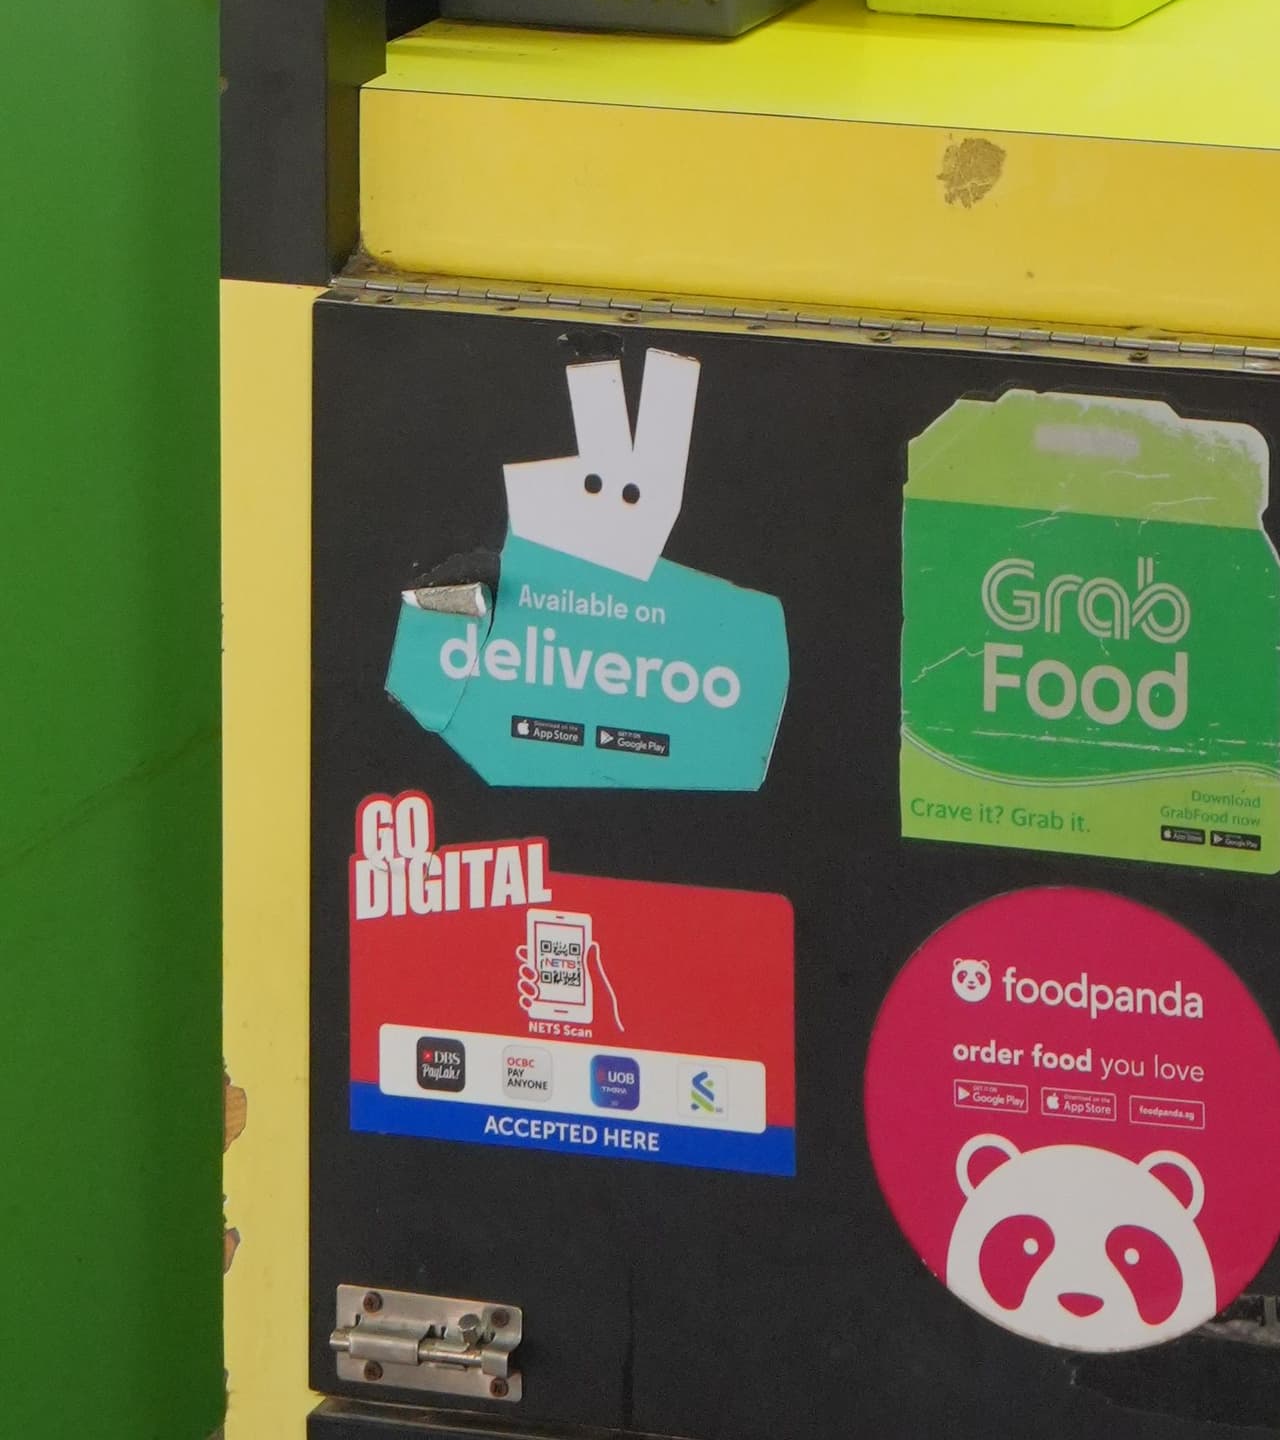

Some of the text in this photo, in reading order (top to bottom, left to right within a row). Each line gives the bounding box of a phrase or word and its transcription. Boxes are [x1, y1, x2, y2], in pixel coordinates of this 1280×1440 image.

[519, 585, 666, 624] Available on
[981, 556, 1191, 644] Grab
[439, 624, 741, 709] deliveroo
[983, 642, 1188, 731] Food
[362, 796, 429, 861] GO
[910, 797, 1091, 833] Crave it? Grab it.
[356, 843, 552, 920] DIGITAL
[1002, 966, 1204, 1019] foodpanda
[529, 1021, 592, 1038] NETS Scan
[952, 1040, 1205, 1083] order food you love
[484, 1115, 660, 1151] ACCEPTED HERE
